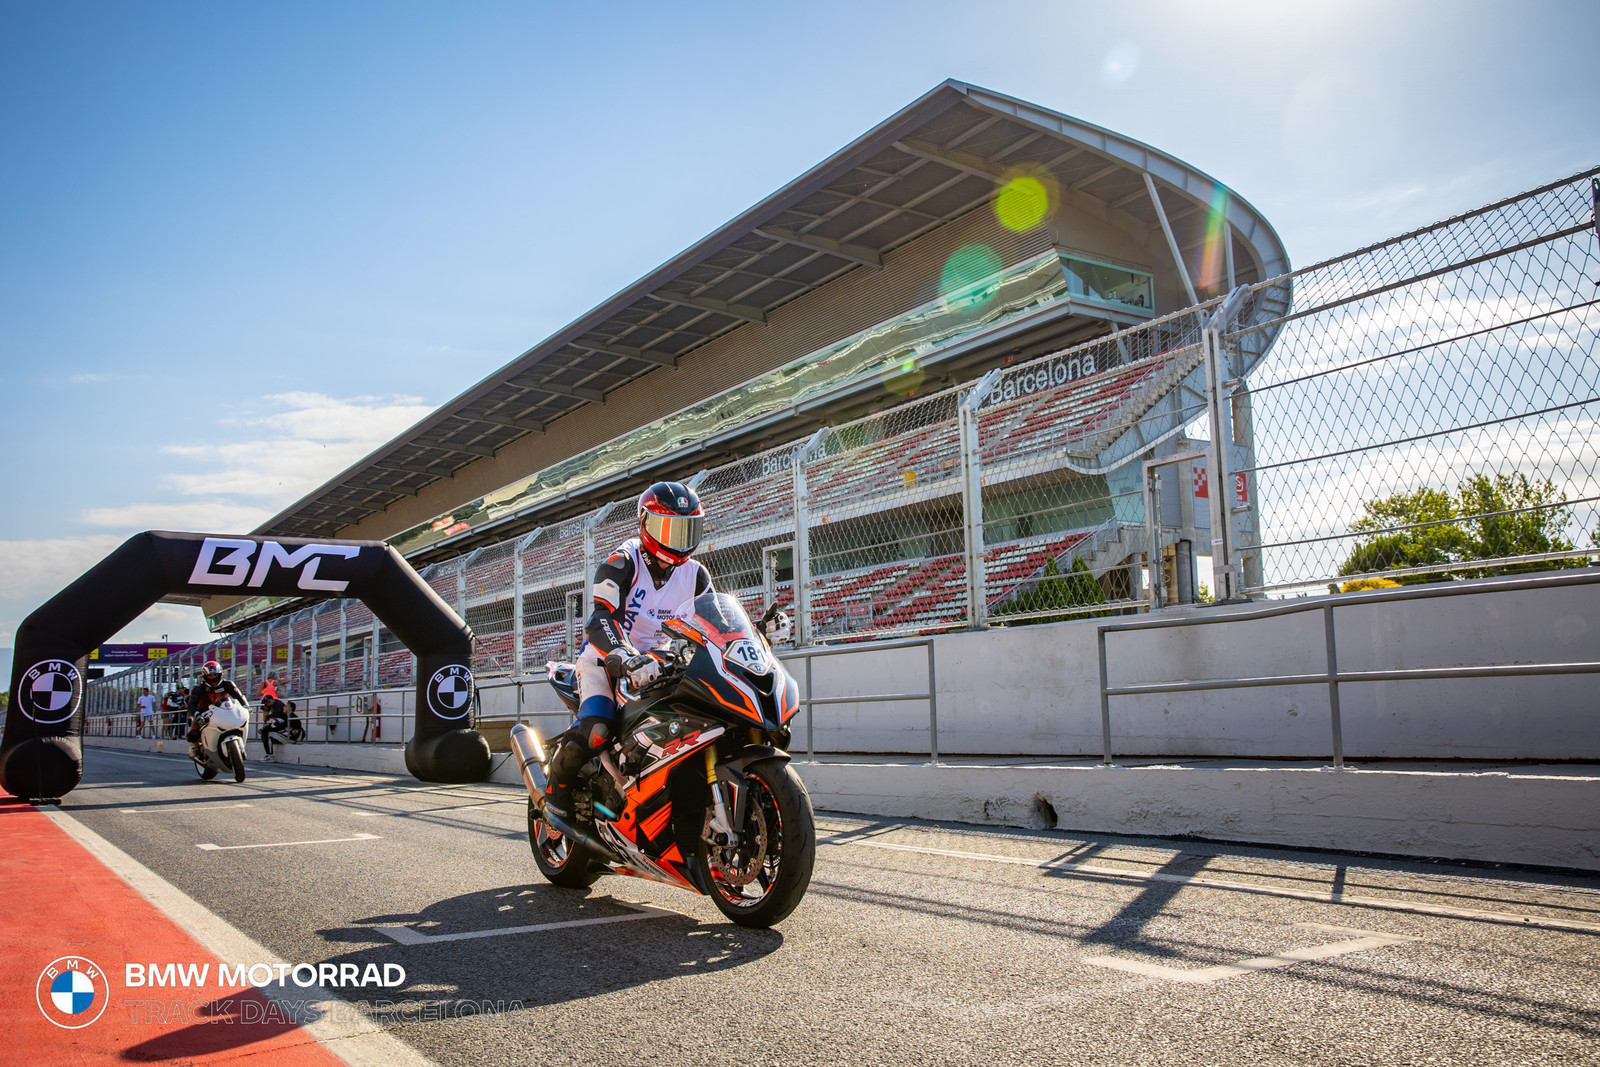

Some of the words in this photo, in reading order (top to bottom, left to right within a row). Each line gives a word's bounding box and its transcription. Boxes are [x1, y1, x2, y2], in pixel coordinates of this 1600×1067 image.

[990, 354, 1096, 405] Barcelona
[188, 537, 361, 592] BMC
[737, 646, 766, 663] 181
[28, 663, 78, 681] BMW
[434, 667, 471, 683] BMW
[662, 730, 701, 757] RR
